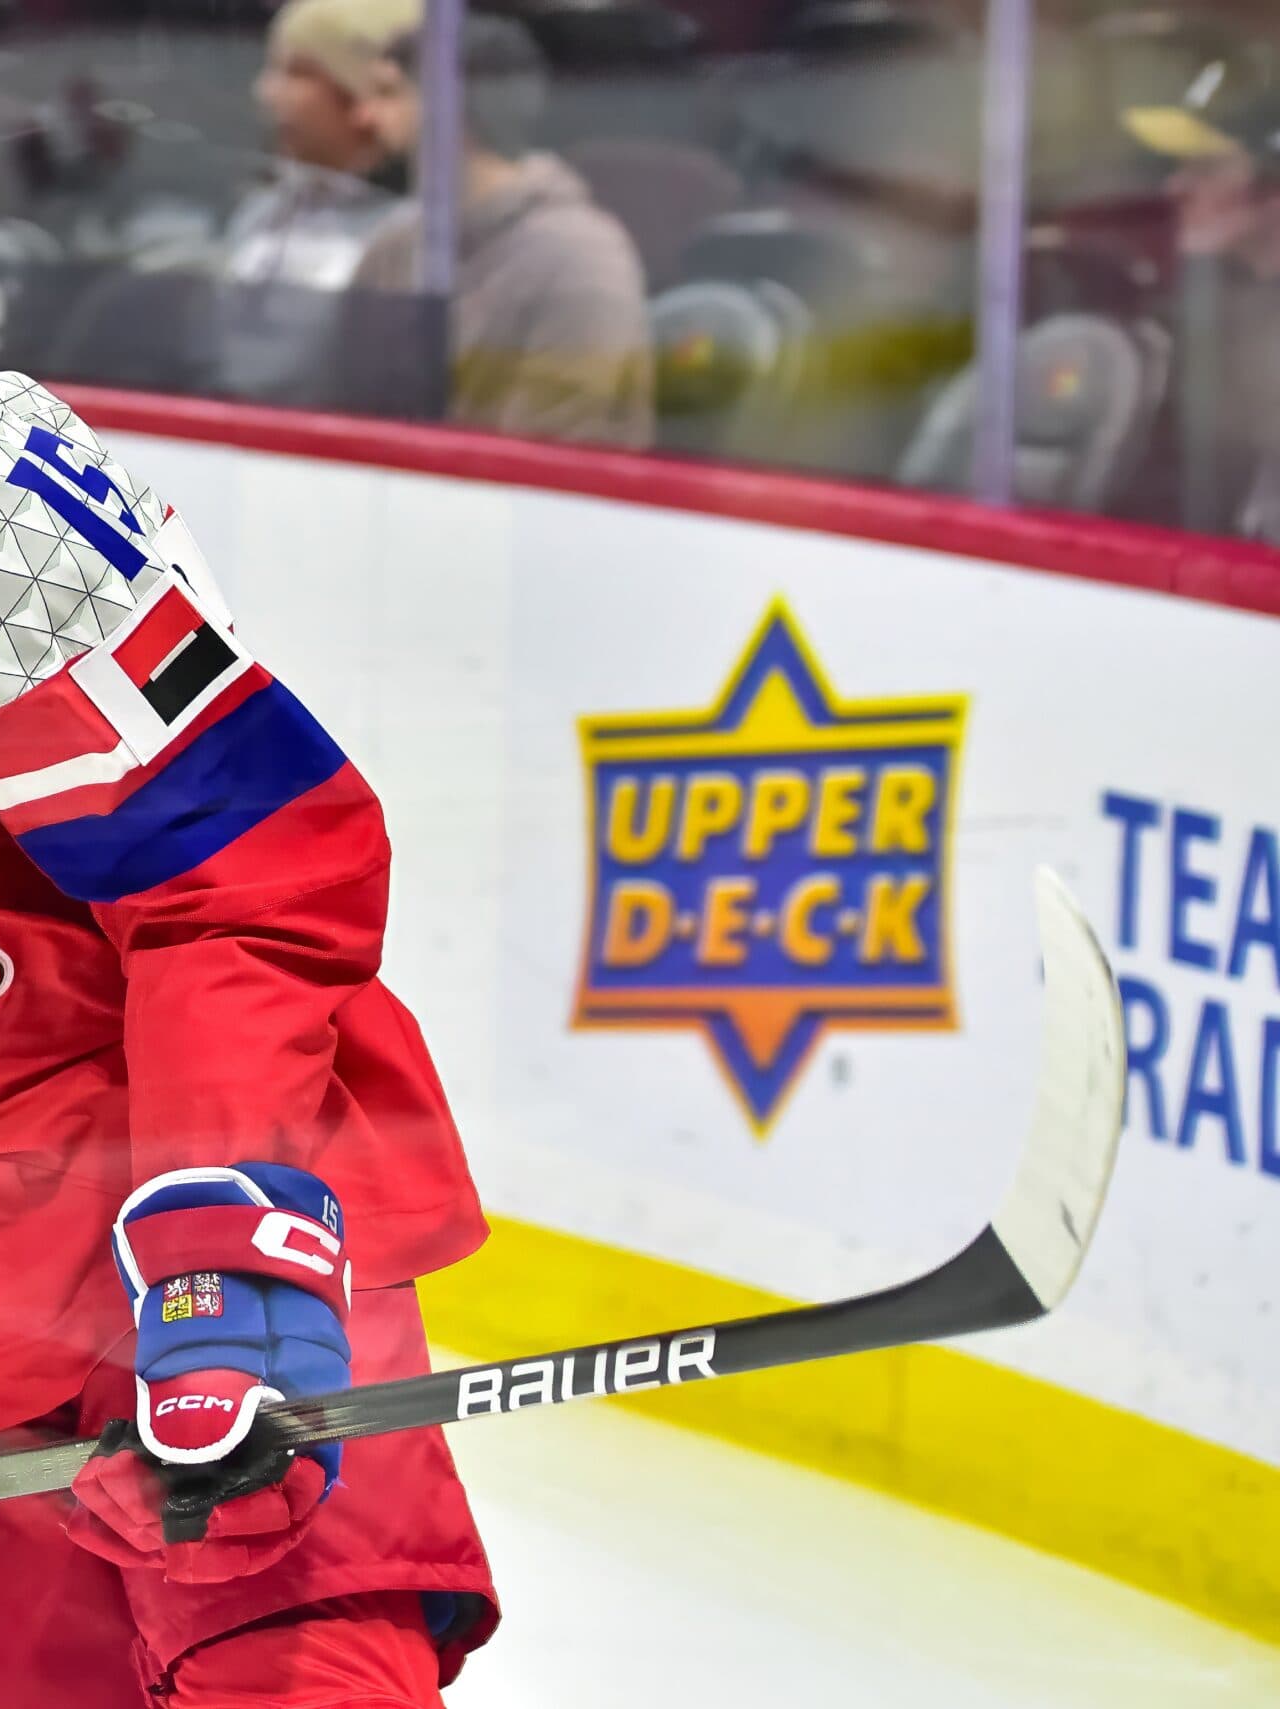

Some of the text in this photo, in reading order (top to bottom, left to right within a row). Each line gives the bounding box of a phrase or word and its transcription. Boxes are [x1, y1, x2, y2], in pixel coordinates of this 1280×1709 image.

[5, 425, 150, 582] 15
[603, 763, 938, 863] UPPER
[321, 1194, 340, 1234] 15
[155, 1394, 234, 1417] CCM
